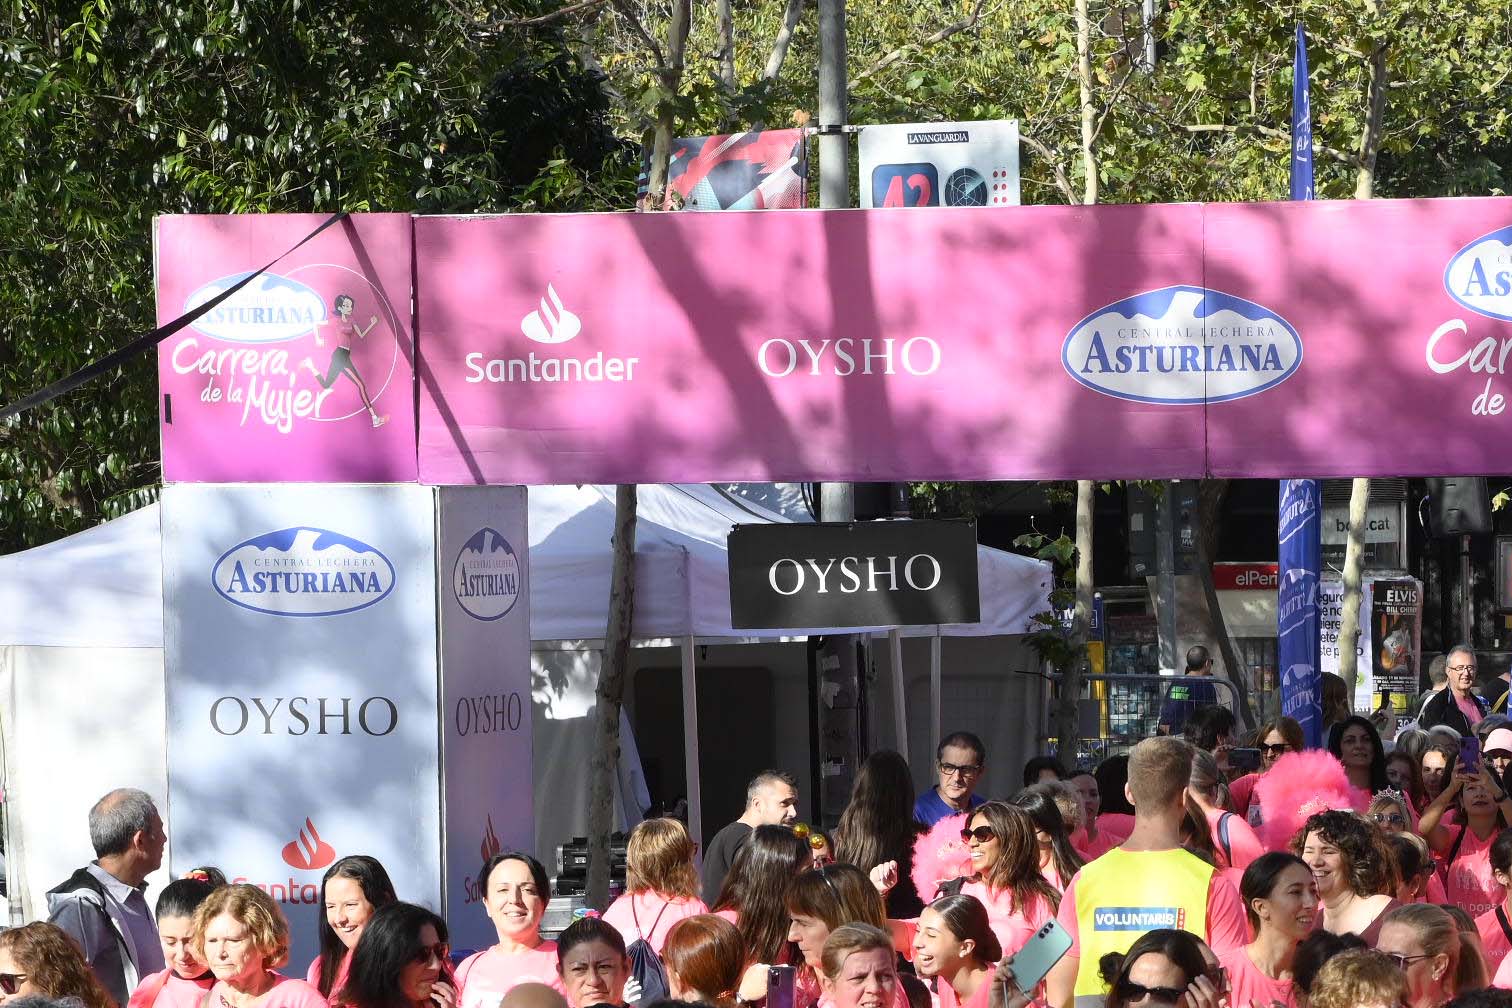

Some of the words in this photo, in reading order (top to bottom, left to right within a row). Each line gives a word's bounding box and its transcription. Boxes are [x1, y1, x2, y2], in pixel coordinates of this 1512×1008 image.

[1117, 326, 1193, 339] CENTRAL
[1201, 325, 1275, 338] LECHERA
[172, 337, 289, 375] Carrera
[465, 351, 639, 384] Santander
[757, 336, 942, 378] OYSHO
[1081, 330, 1285, 375] ASTURIANA
[200, 379, 223, 404] de
[226, 379, 243, 404] la
[240, 372, 335, 434] Mujer
[1471, 377, 1506, 416] de
[226, 560, 383, 594] ASTURIANA
[254, 558, 311, 567] CENTRAL
[317, 558, 376, 567] LECHERA
[458, 562, 517, 598] ASTURIANA
[768, 553, 942, 596] OYSHO
[1386, 589, 1417, 602] ELVIS
[209, 696, 399, 737] OYSHO
[456, 692, 523, 737] OYSHO
